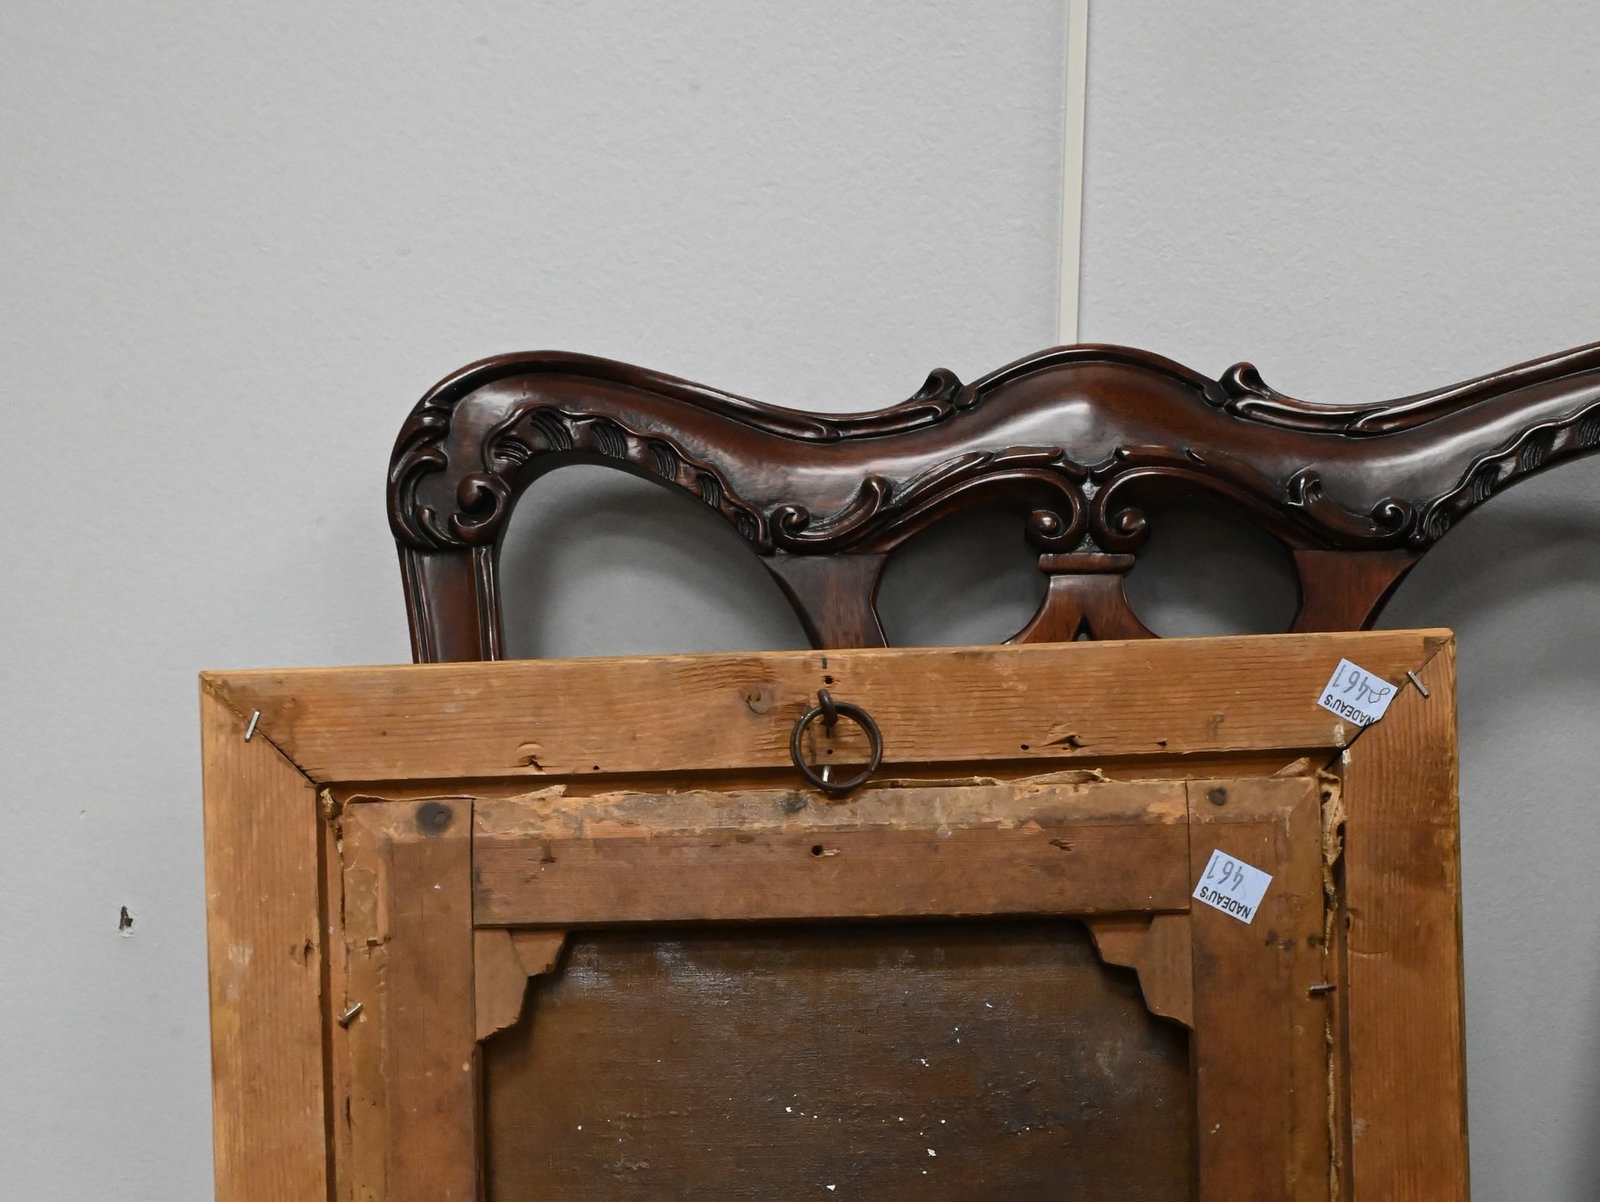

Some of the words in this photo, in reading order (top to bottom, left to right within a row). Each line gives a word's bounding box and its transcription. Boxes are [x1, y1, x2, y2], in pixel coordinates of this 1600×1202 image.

[1324, 694, 1375, 726] NADEAU'S
[1207, 855, 1244, 891] 461
[1200, 886, 1252, 919] NADEAU'S
